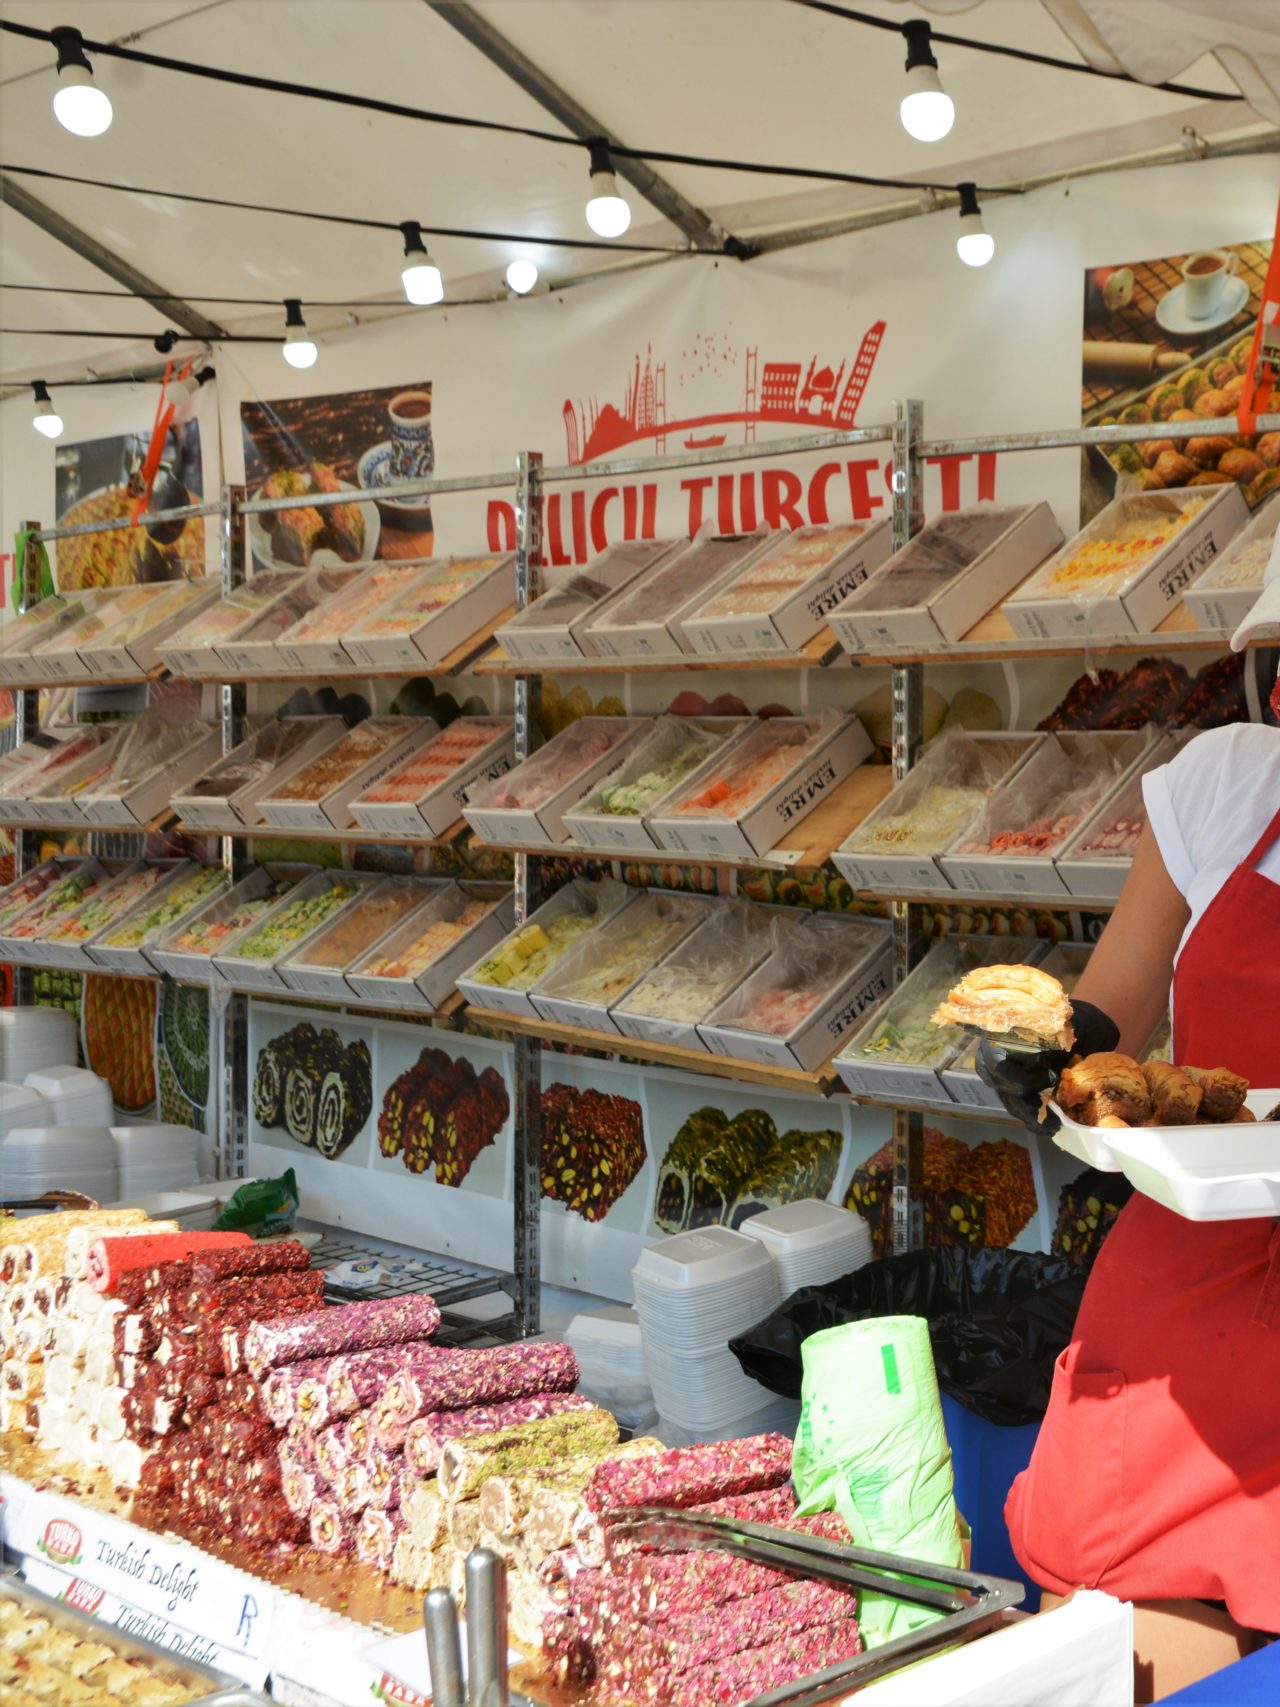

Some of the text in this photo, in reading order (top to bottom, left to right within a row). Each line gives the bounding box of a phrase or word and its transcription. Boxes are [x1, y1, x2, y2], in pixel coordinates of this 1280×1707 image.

[487, 453, 997, 567] DLICII TURCETI
[810, 567, 869, 621] EMRE
[1163, 541, 1217, 601] EMRE
[780, 767, 836, 822] EMRE
[831, 979, 886, 1038] EMRE
[96, 1539, 200, 1611] Turkish Delight
[115, 1604, 169, 1644] Turkish
